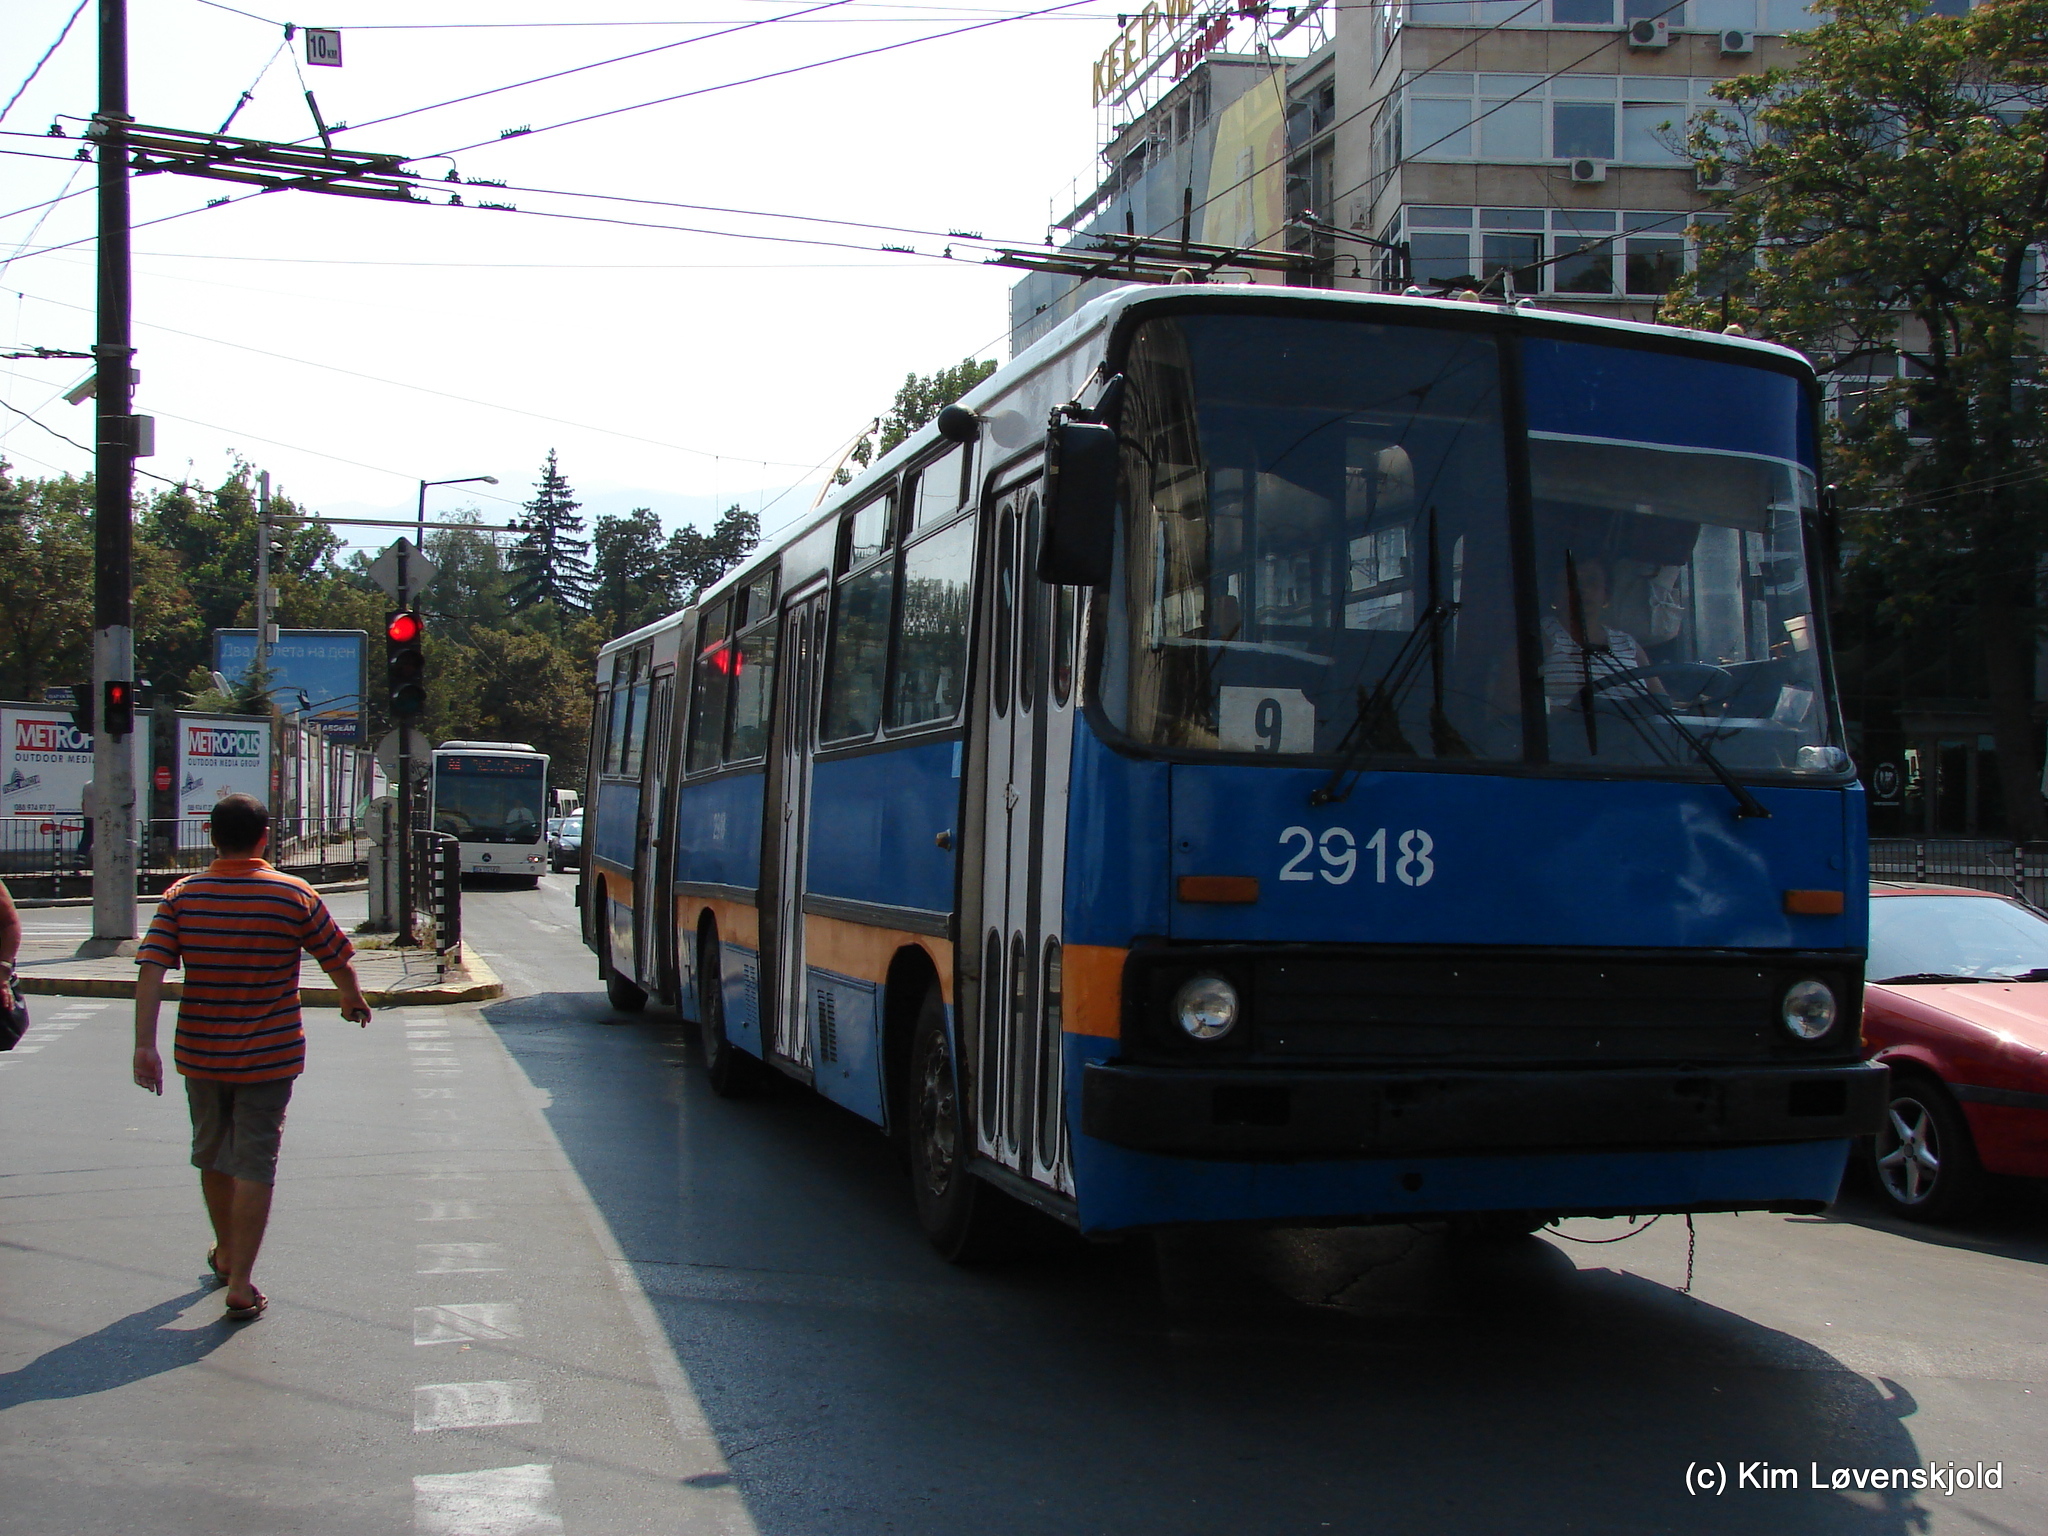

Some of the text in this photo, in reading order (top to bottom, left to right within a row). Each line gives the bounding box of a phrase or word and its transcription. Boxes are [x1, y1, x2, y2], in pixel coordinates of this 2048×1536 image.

[311, 35, 326, 59] 10
[1093, 0, 1160, 109] KEEP
[222, 643, 250, 658] Два
[308, 647, 325, 658] на
[328, 647, 356, 660] ден
[1255, 698, 1282, 753] 9
[188, 730, 260, 754] METROPOLIS
[15, 753, 95, 764] OUTDOOR MEDI
[188, 758, 260, 768] OUTDOOR MEDIA GROUP
[1278, 825, 1434, 887] 2918
